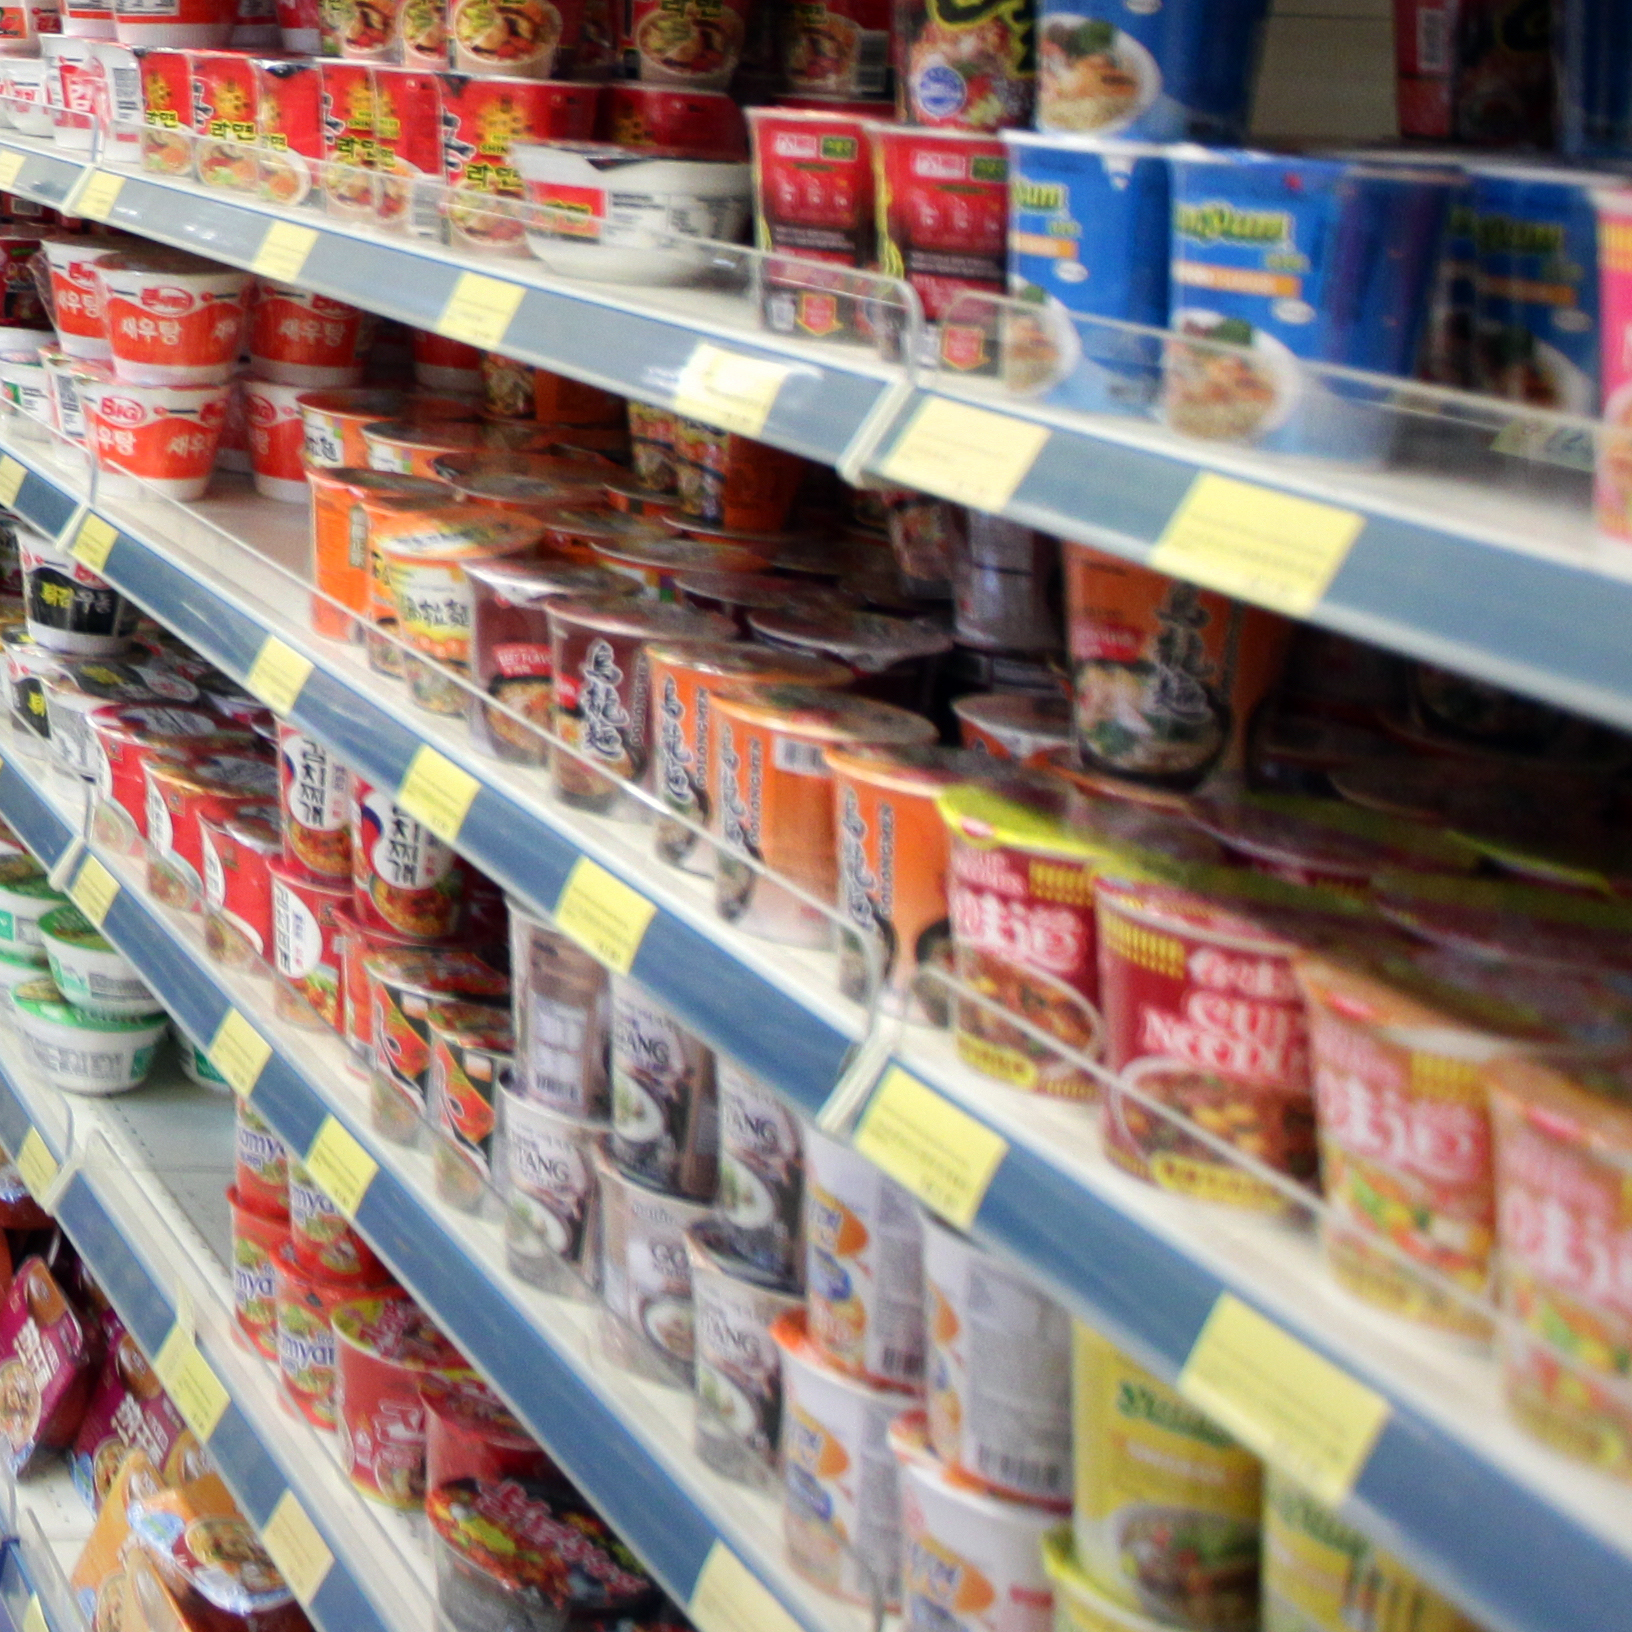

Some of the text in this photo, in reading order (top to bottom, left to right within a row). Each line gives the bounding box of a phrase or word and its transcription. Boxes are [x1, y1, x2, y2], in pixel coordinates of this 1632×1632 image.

[210, 120, 256, 143] 라면
[120, 317, 183, 346] 새우탕
[101, 397, 144, 421] BIG
